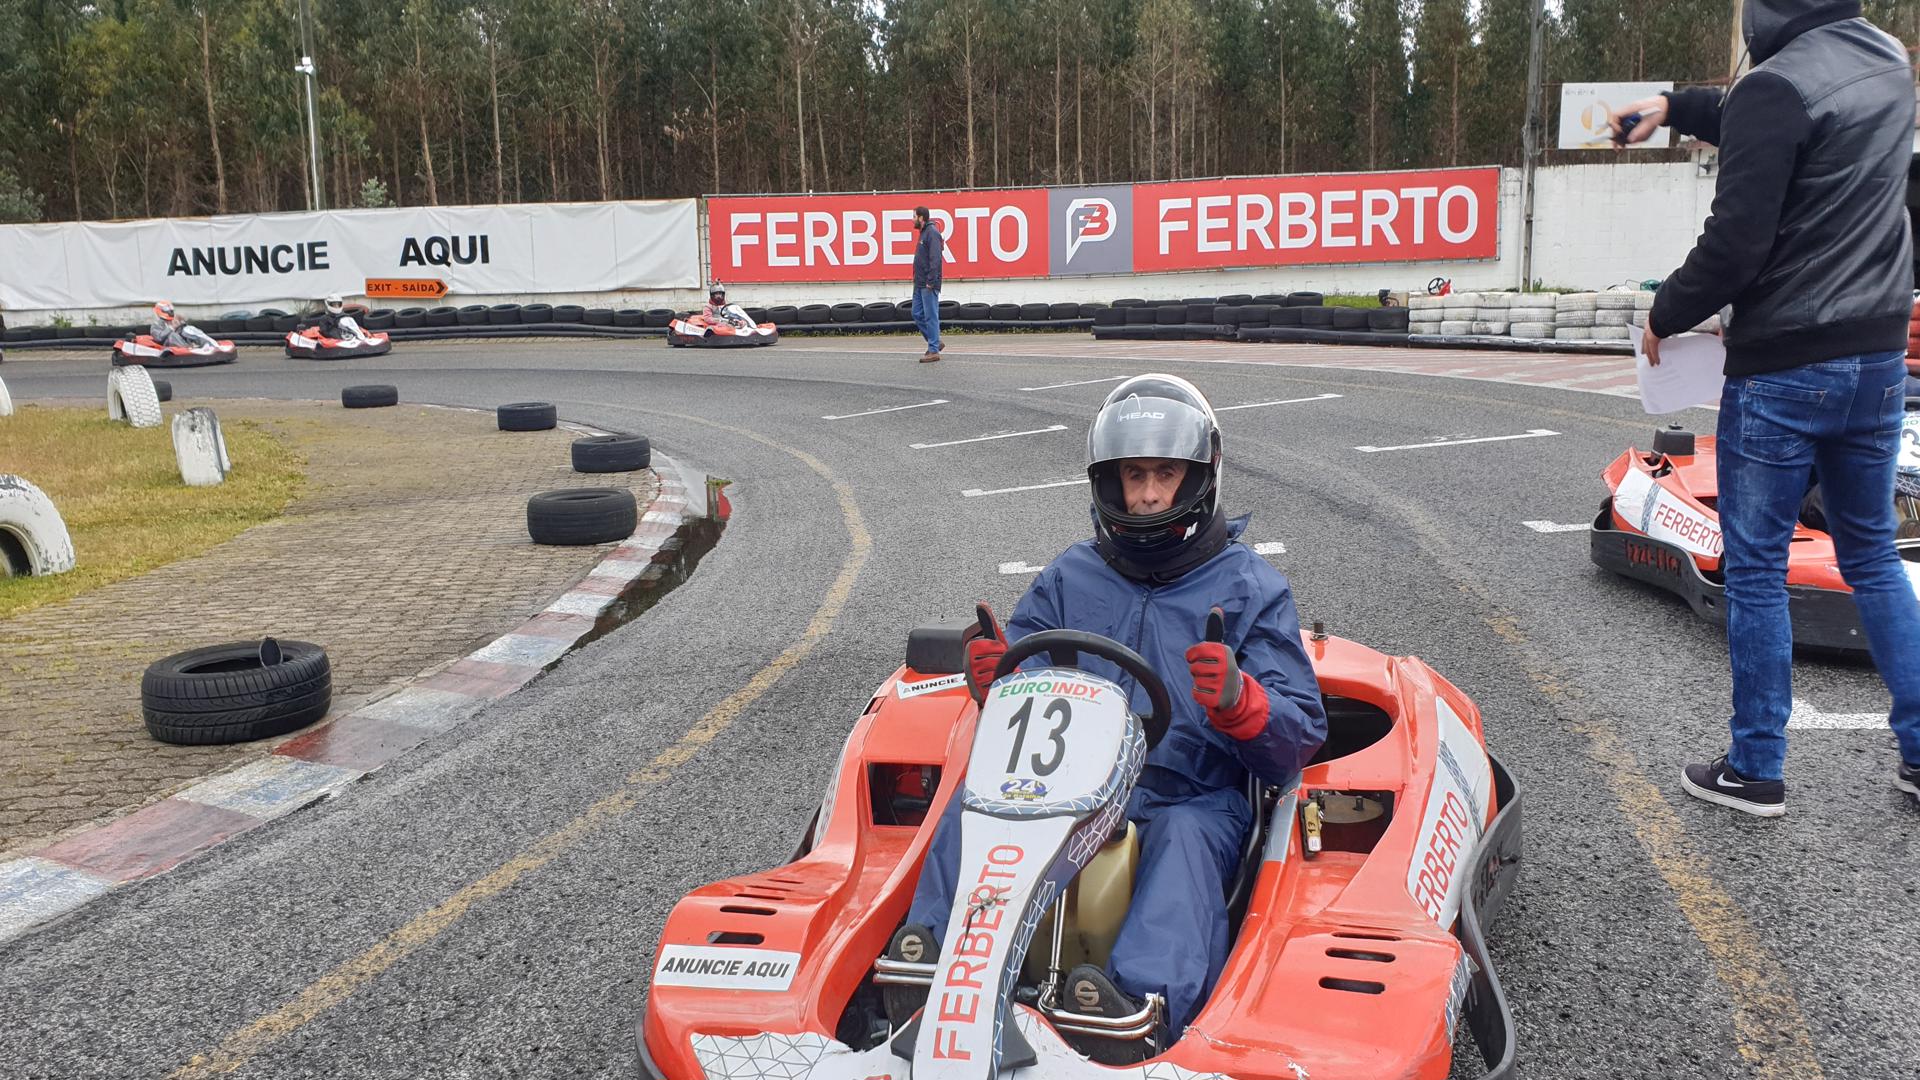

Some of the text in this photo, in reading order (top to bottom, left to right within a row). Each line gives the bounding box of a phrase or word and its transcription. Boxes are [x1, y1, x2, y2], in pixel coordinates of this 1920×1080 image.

[730, 204, 1030, 268] FERBERTO
[1158, 184, 1480, 256] FERBERTO
[166, 234, 491, 277] ANUNCIE AQUI
[367, 283, 392, 292] EXIT
[402, 282, 436, 292] SAÍDA
[1118, 411, 1164, 421] HEAD
[903, 677, 960, 694] ANUNCIE
[999, 680, 1102, 699] EUROINDY
[1005, 696, 1073, 777] 13
[661, 957, 790, 978] ANUNCIE AQUI
[932, 844, 1025, 1061] FERBERTO
